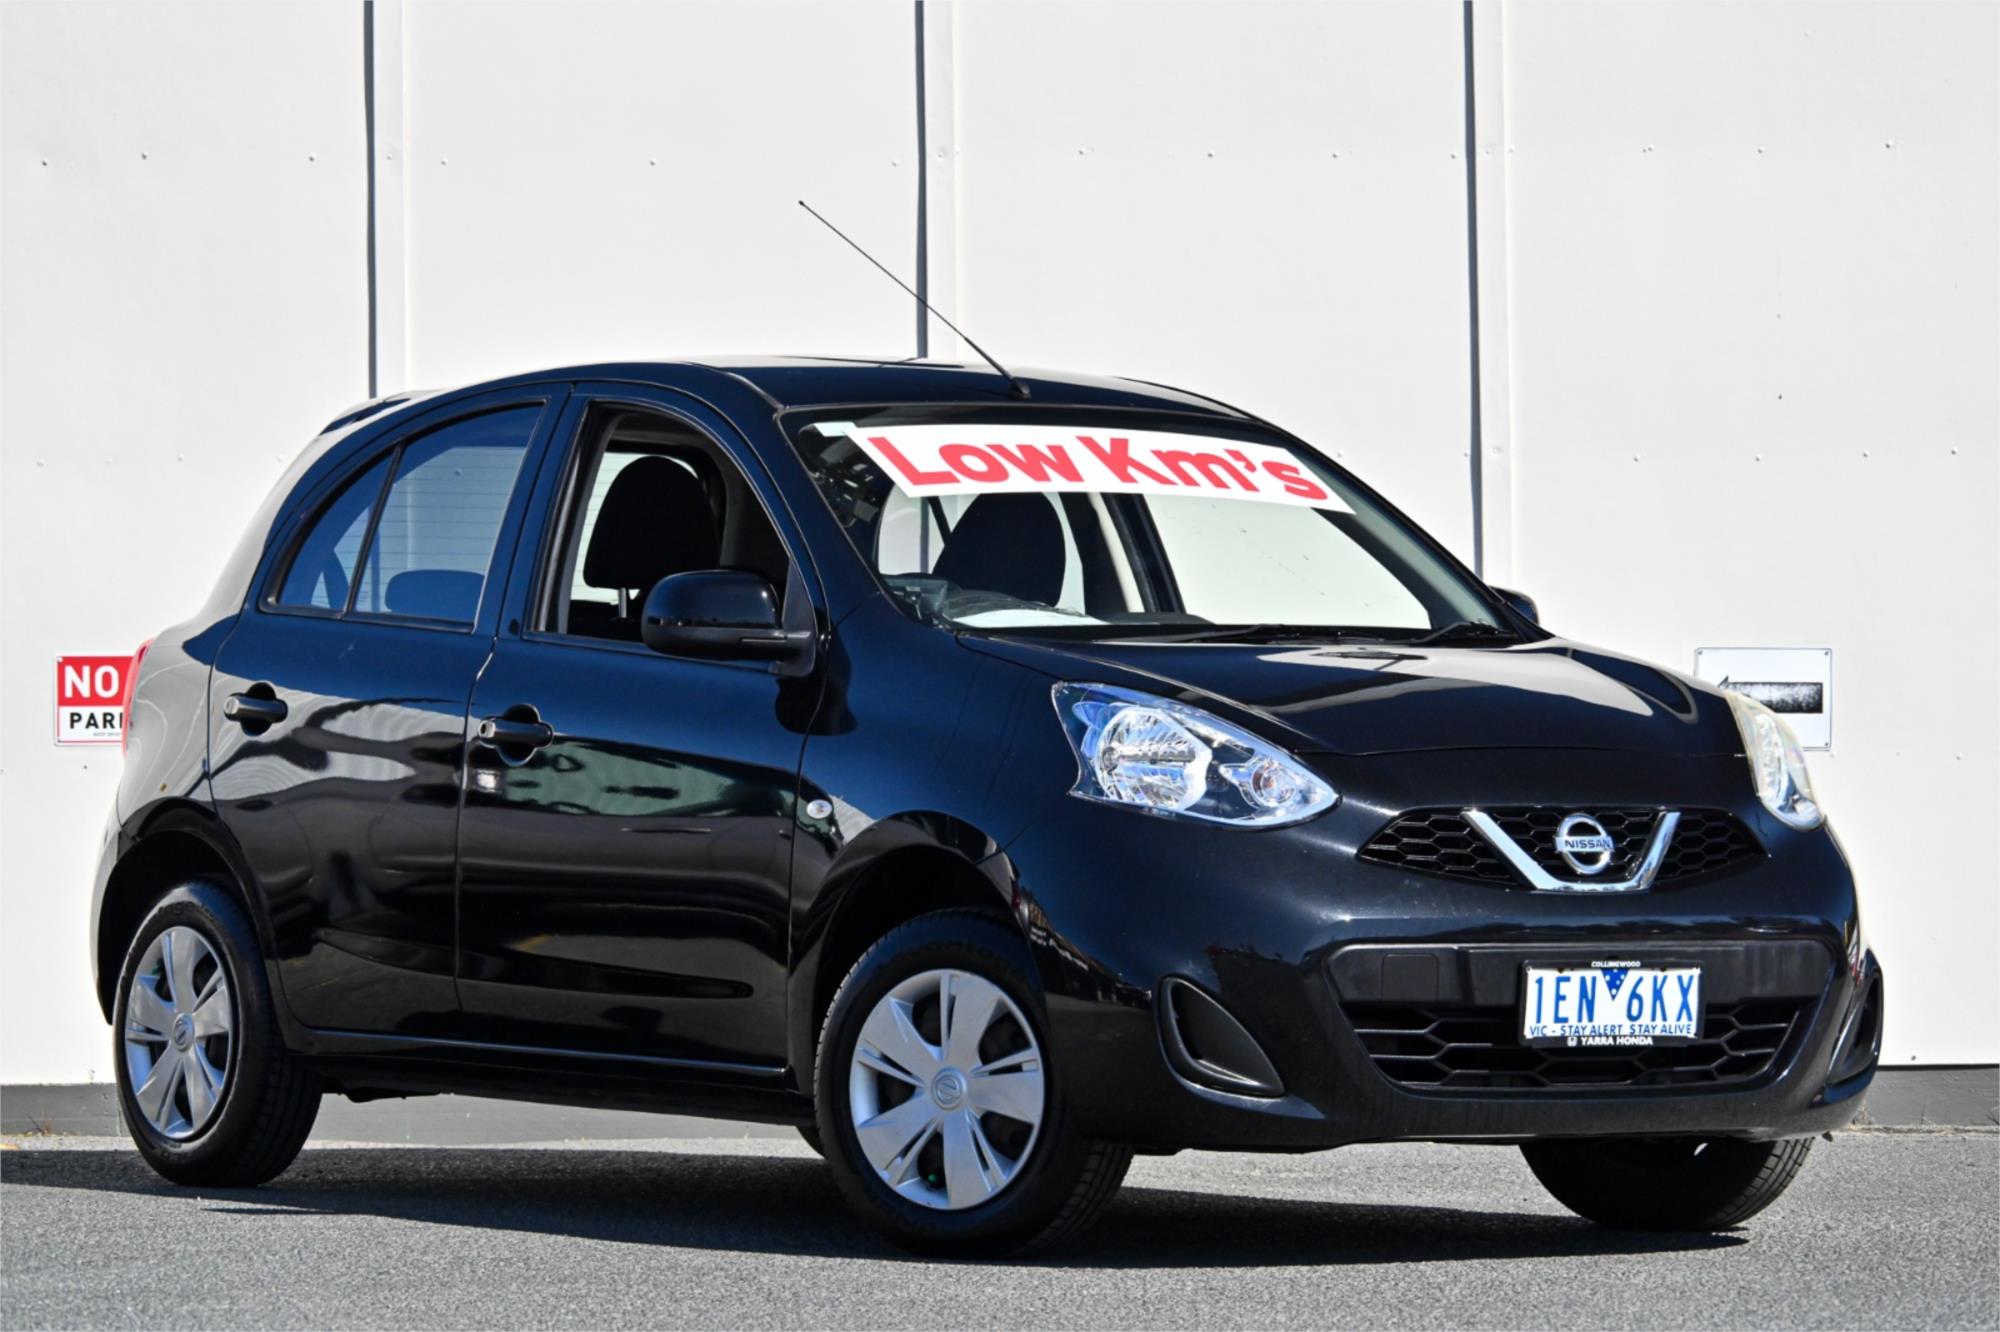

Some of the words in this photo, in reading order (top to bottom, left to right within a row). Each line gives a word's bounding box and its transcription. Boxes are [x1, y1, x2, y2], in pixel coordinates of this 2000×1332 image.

[869, 437, 1082, 486] Low
[1078, 436, 1328, 501] Km's
[64, 665, 119, 698] NO
[70, 712, 123, 729] PAR
[1565, 839, 1611, 849] NISSAN
[1530, 1026, 1547, 1036] VIC
[1560, 1025, 1586, 1036] STAY
[1590, 1024, 1623, 1036] ALERT
[1630, 1024, 1657, 1035] STAY
[1661, 1024, 1692, 1035] ALIVE
[1581, 1037, 1614, 1046] YARRA
[1616, 1036, 1653, 1046] HONDA
